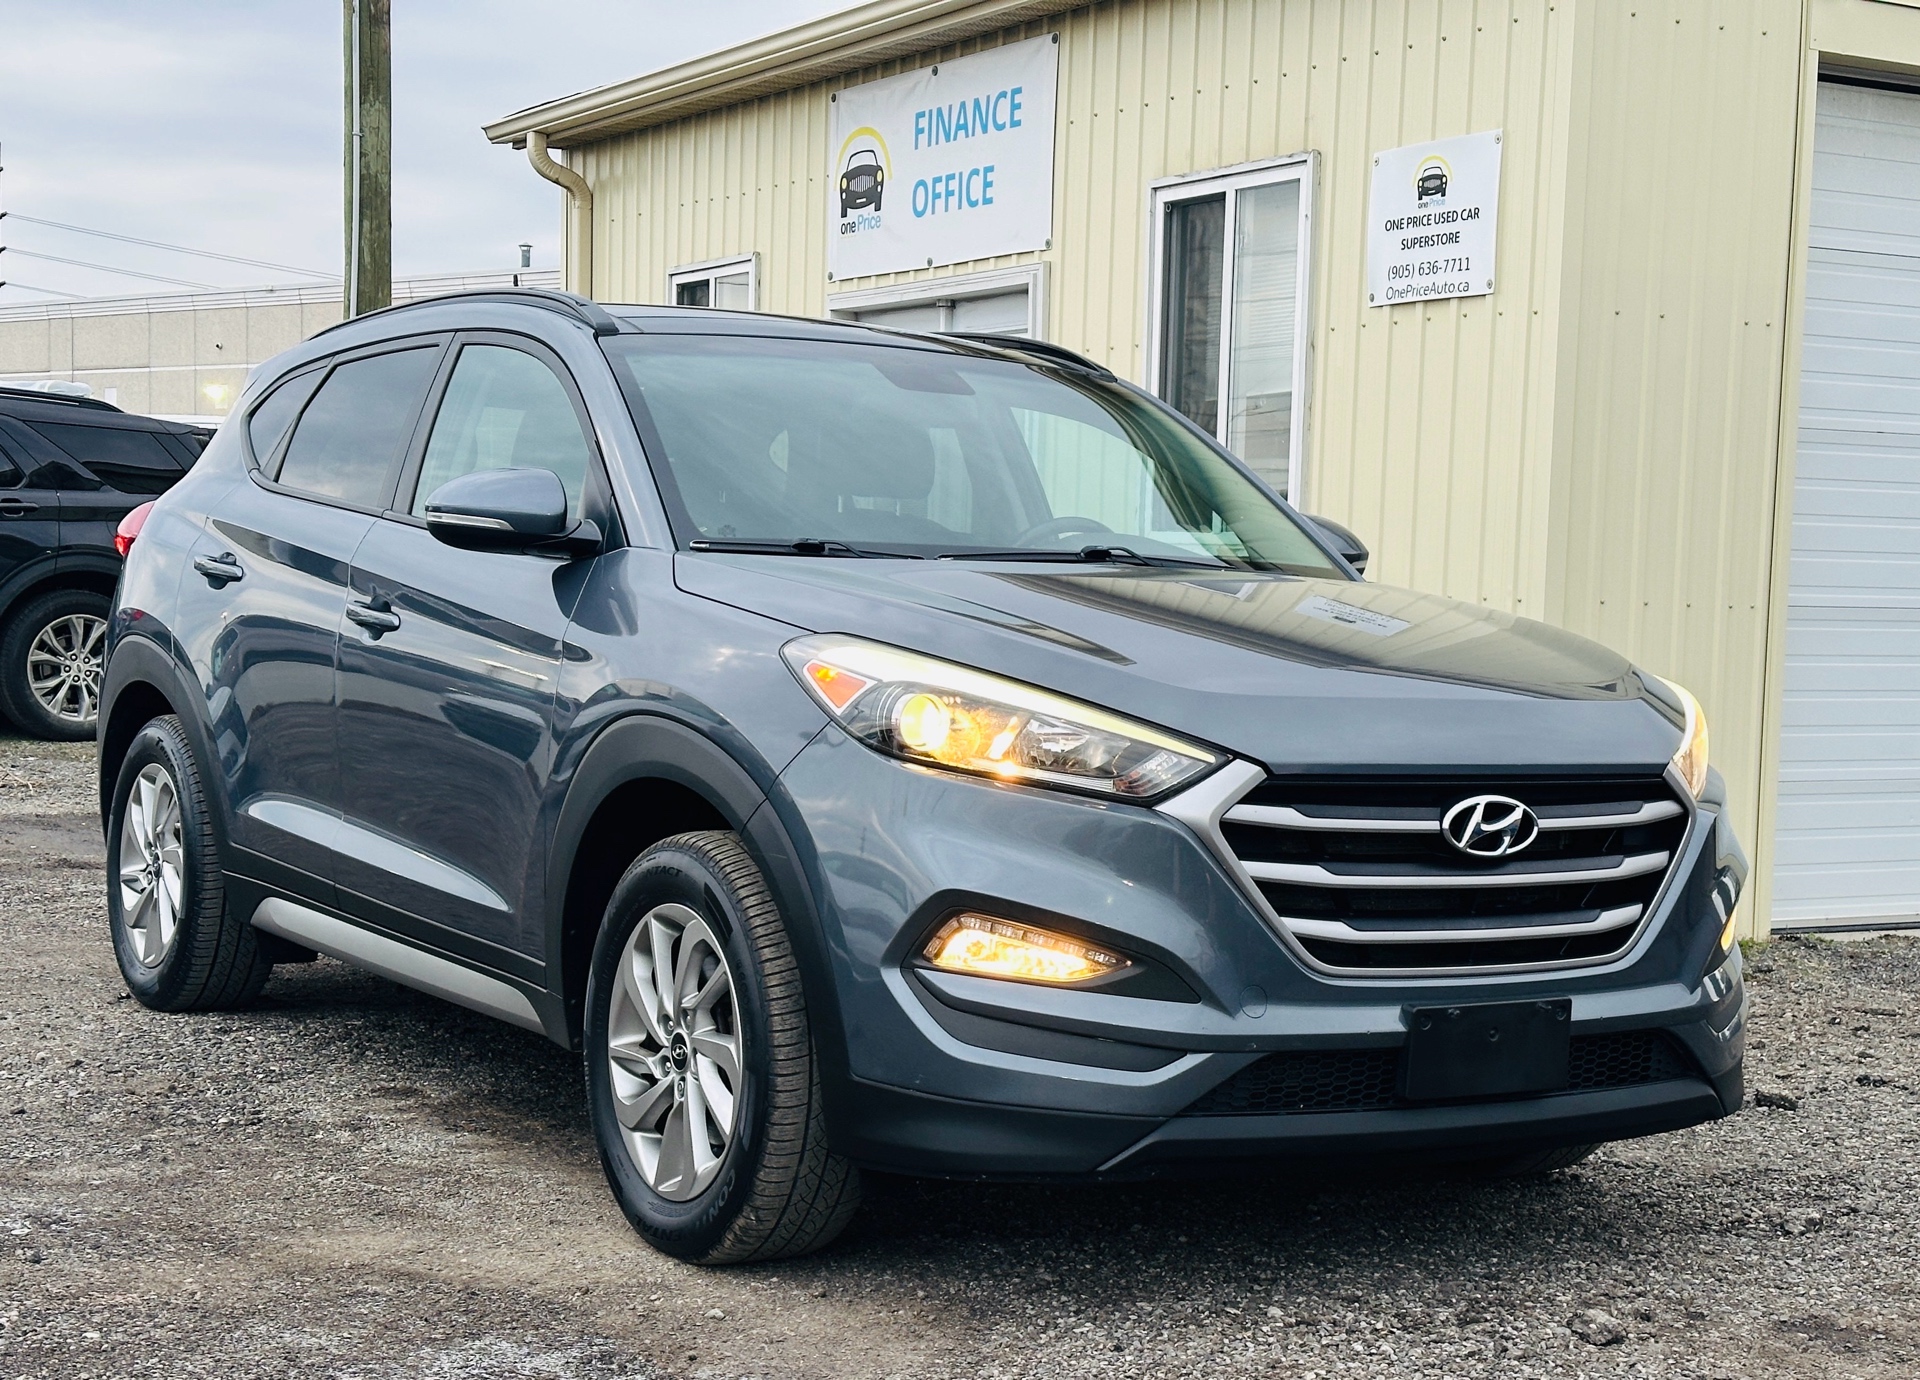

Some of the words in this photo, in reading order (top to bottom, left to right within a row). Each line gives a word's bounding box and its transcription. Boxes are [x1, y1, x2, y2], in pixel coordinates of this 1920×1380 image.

[914, 86, 1023, 150] FINANCE
[912, 165, 995, 218] OFFICE
[1384, 217, 1405, 232] ONE
[1406, 214, 1432, 230] PRICE
[1434, 210, 1459, 225] USED
[1460, 207, 1480, 221] CAR
[1401, 231, 1461, 250] SUPERSTORE
[1387, 263, 1415, 282] (905)
[1418, 257, 1471, 277] 636-7711
[1386, 281, 1470, 300] OnePriceAuto.ca
